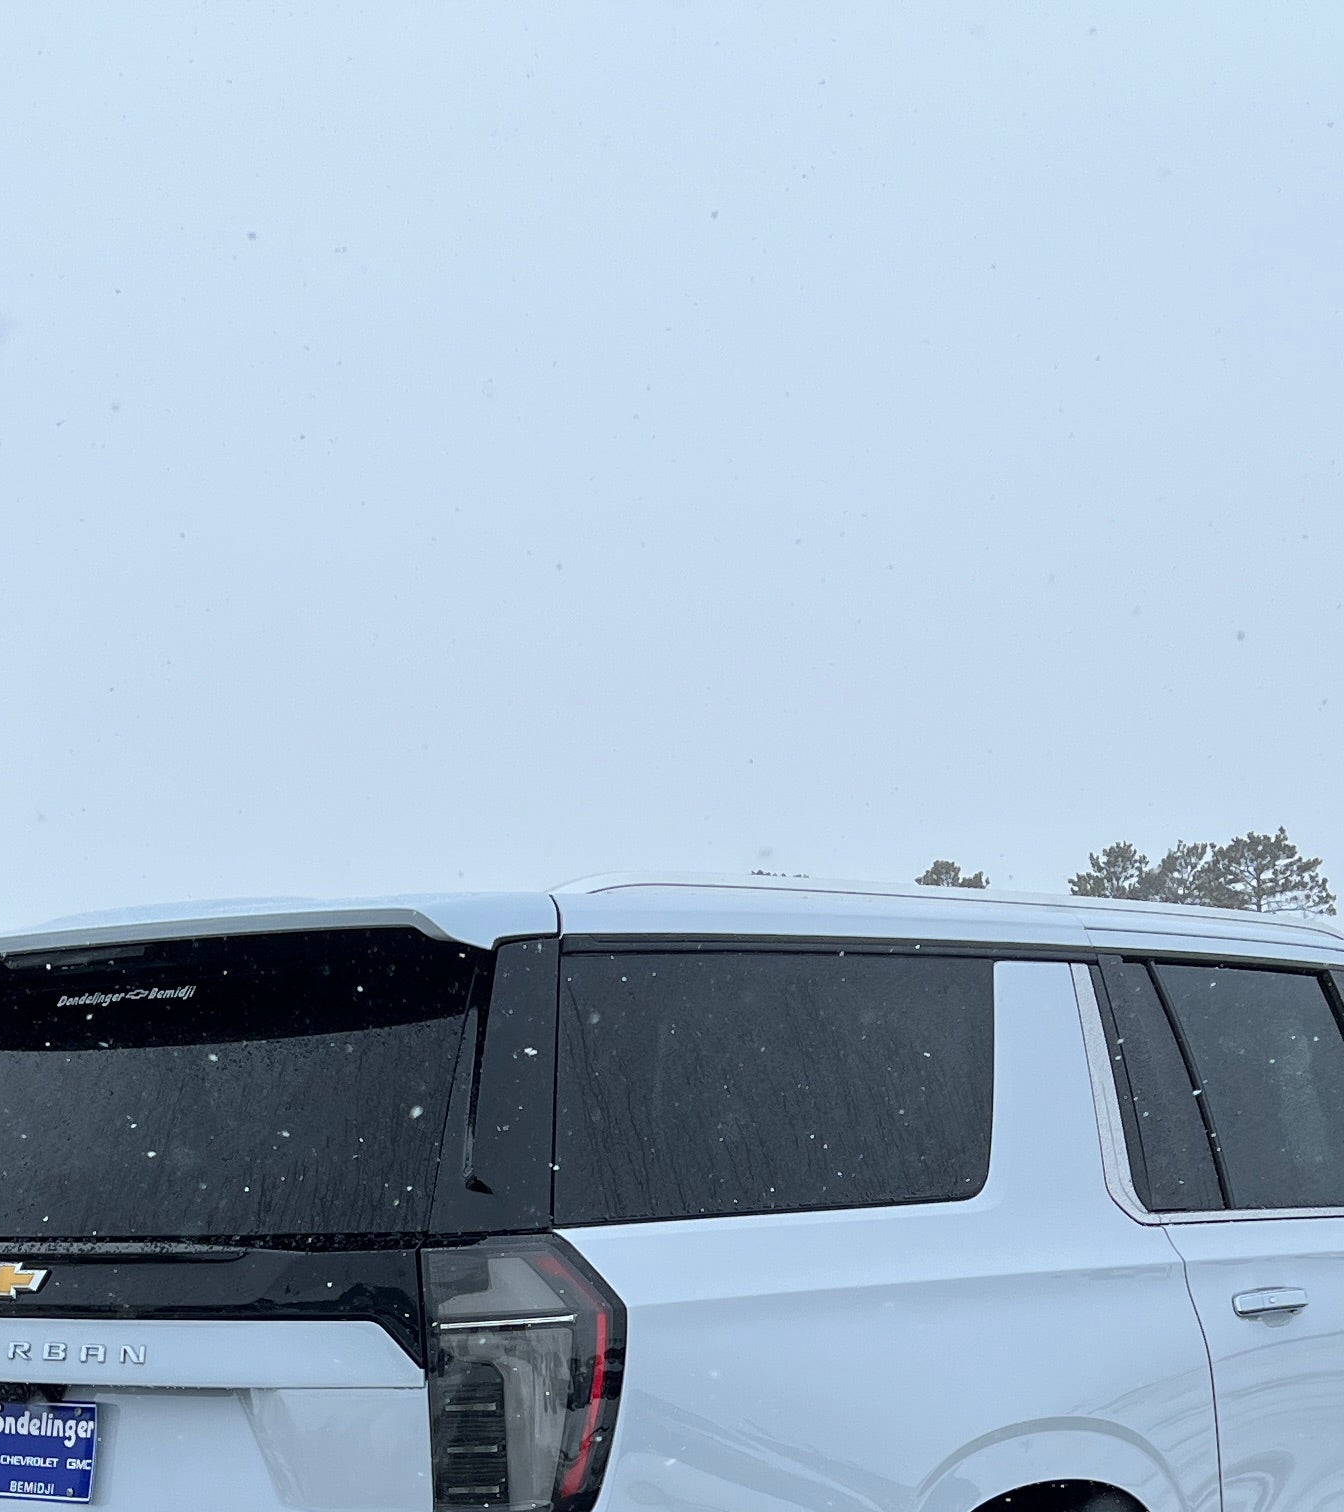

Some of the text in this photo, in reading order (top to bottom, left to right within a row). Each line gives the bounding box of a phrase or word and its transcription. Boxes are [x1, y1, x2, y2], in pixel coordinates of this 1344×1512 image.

[57, 985, 197, 1008] Dondelinger Bemidji
[0, 1453, 93, 1471] CHEVROLET GMC
[9, 1480, 55, 1495] BEMIDJI
